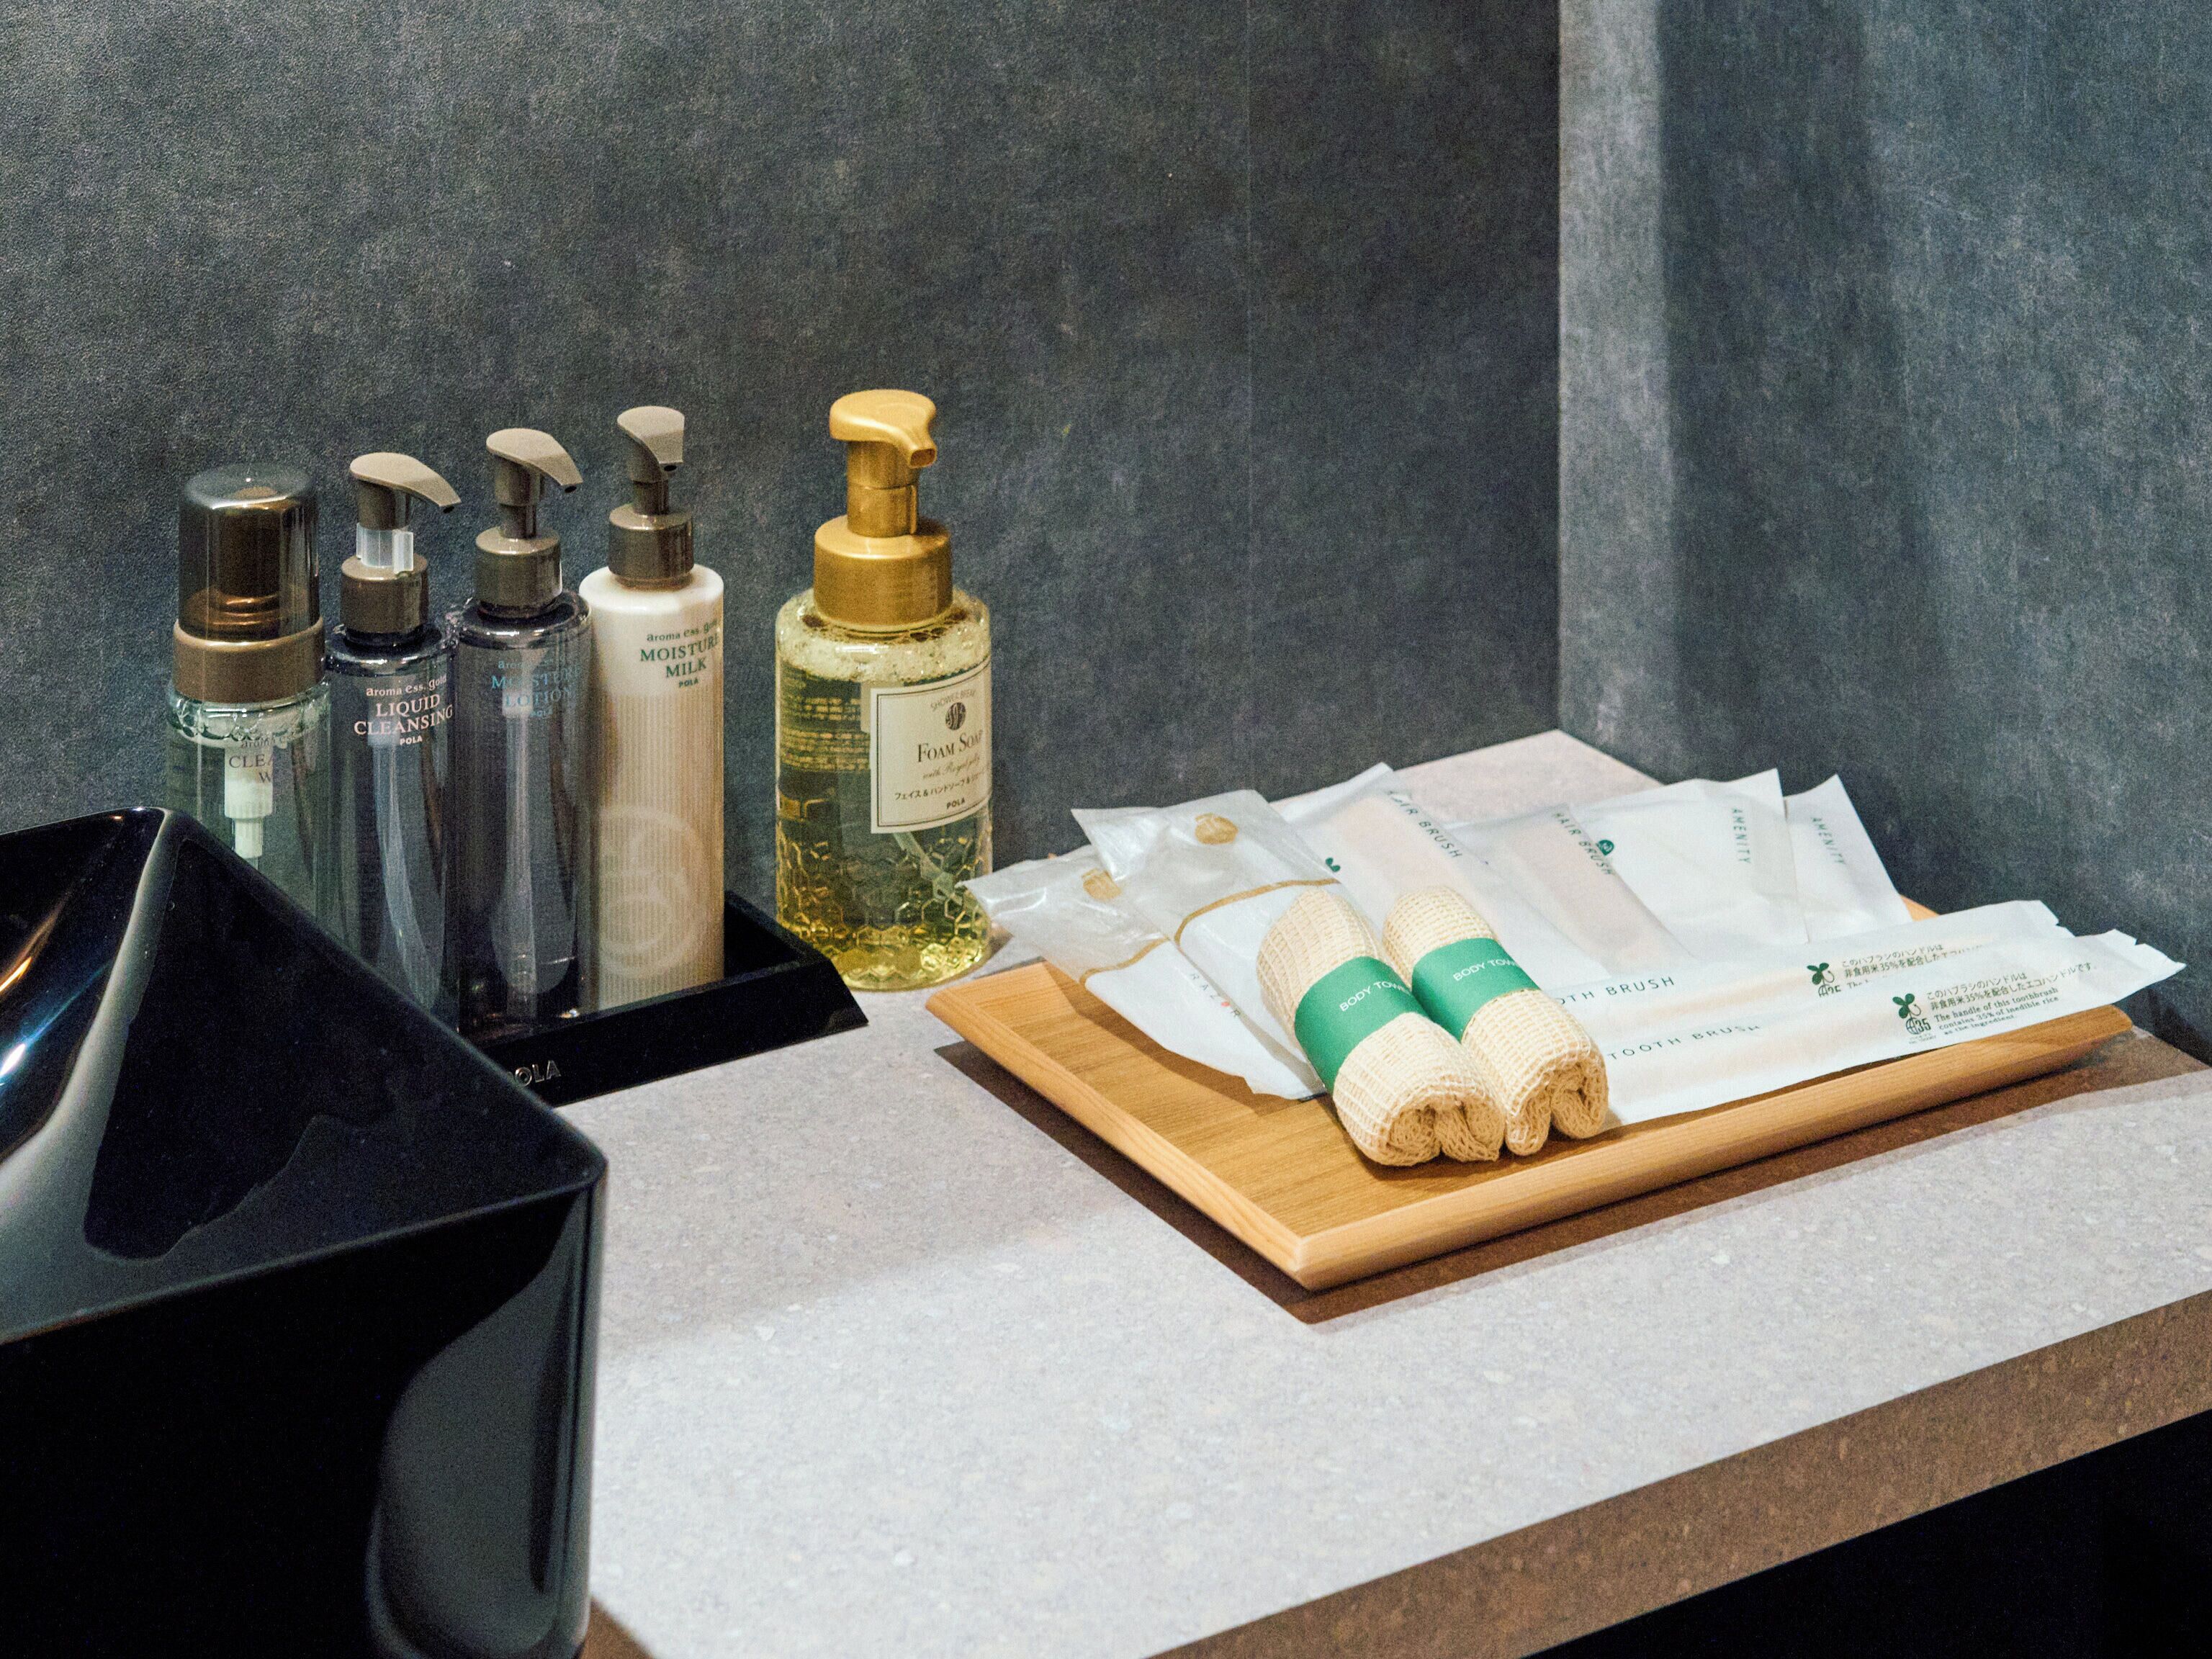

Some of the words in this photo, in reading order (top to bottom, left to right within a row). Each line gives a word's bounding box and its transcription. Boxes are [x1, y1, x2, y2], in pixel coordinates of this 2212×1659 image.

[639, 633, 719, 662] MOISTURE
[666, 656, 707, 678] MILK
[366, 687, 403, 696] aroma
[428, 674, 447, 691] gold
[678, 678, 698, 688] POLA
[375, 693, 441, 718] LIQUID
[354, 704, 454, 735] CLEANSING
[400, 735, 423, 746] POLA
[946, 797, 966, 809] POLA
[1419, 820, 1463, 858] BRUSH
[1731, 808, 1751, 863] AMENITY
[1578, 840, 1613, 875] BRUSH
[1453, 962, 1485, 981] BODY
[1339, 986, 1372, 1012] BODY
[1606, 976, 1675, 996] BRUSH
[1934, 1013, 1951, 1022] The
[1952, 1007, 1982, 1018] handle
[1983, 1002, 1992, 1010] of
[1994, 999, 2010, 1008] this
[2012, 986, 2059, 1004] toothbrush
[1939, 1017, 1974, 1030] contains
[1976, 1012, 1995, 1021] 35%
[2006, 1002, 2041, 1014] inedible
[2042, 996, 2059, 1005] rice
[1915, 1017, 1932, 1032] 35
[1607, 1038, 1681, 1061] TOOTH
[1691, 1025, 1761, 1040] BRUSH
[505, 1060, 562, 1087] OLA
